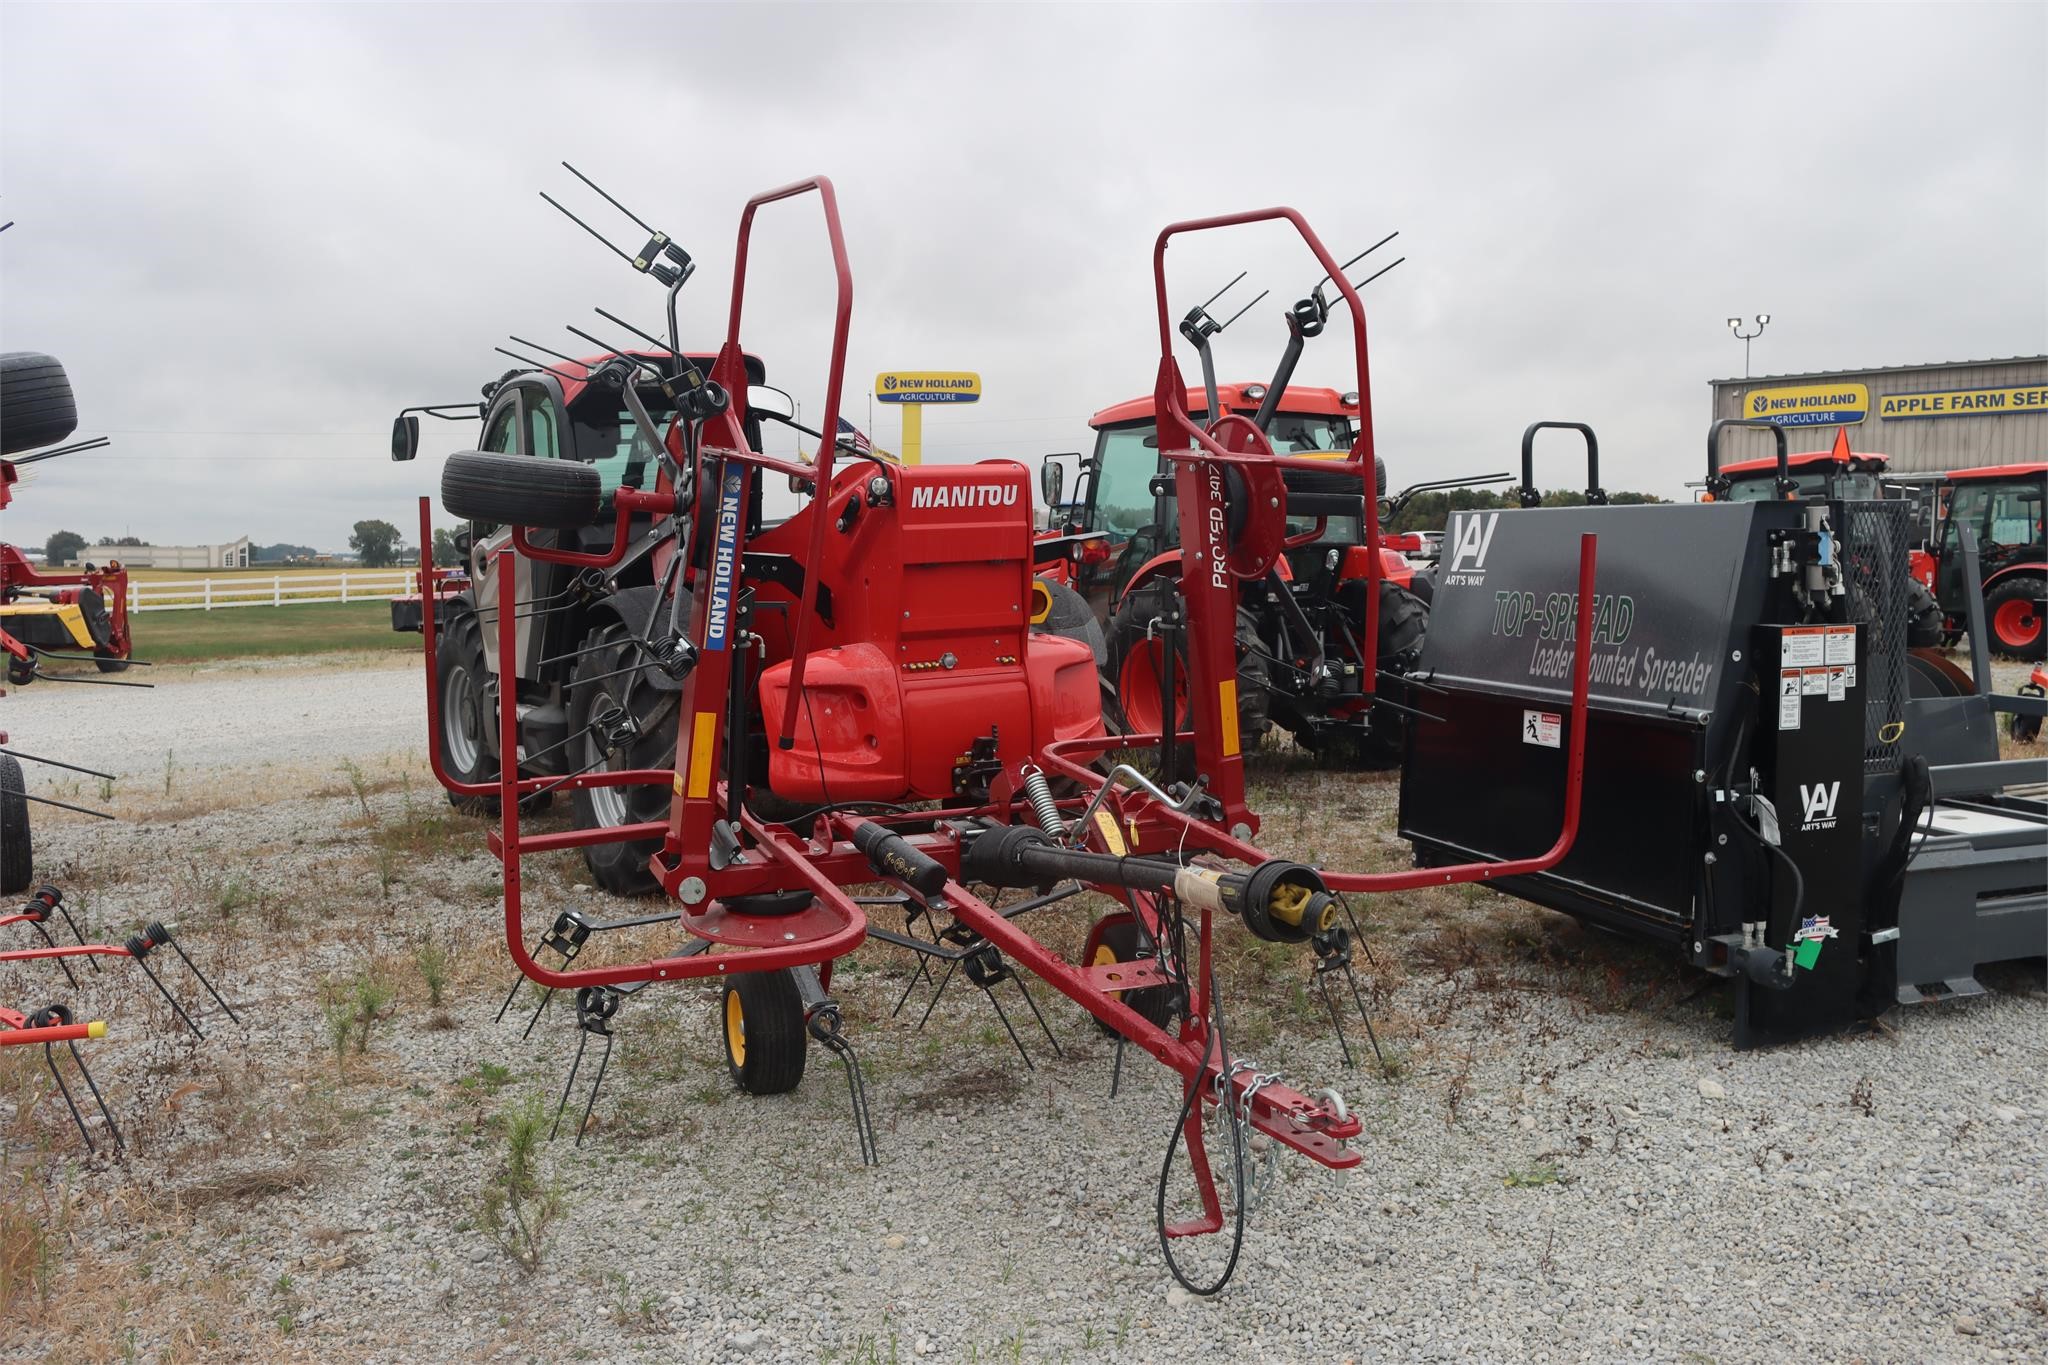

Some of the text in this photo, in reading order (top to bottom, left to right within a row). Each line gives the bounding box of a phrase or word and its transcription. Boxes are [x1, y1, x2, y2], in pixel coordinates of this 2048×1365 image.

[900, 379, 973, 388] NEW HOLLAND
[899, 393, 956, 401] AGRICULTURE
[1770, 393, 1857, 409] NEW HOLLAND
[1883, 397, 1945, 413] APPLE
[1951, 393, 2006, 410] FARM
[1770, 412, 1836, 424] AGRICULTURE
[911, 485, 1018, 508] MANITOU
[1208, 464, 1228, 589] PROTED 3417
[708, 497, 739, 639] NEW HOLLAND
[1445, 575, 1485, 586] ART'S WAY
[1529, 638, 1713, 697] Loader ounted Spreader
[1801, 820, 1837, 831] ART'S WAY
